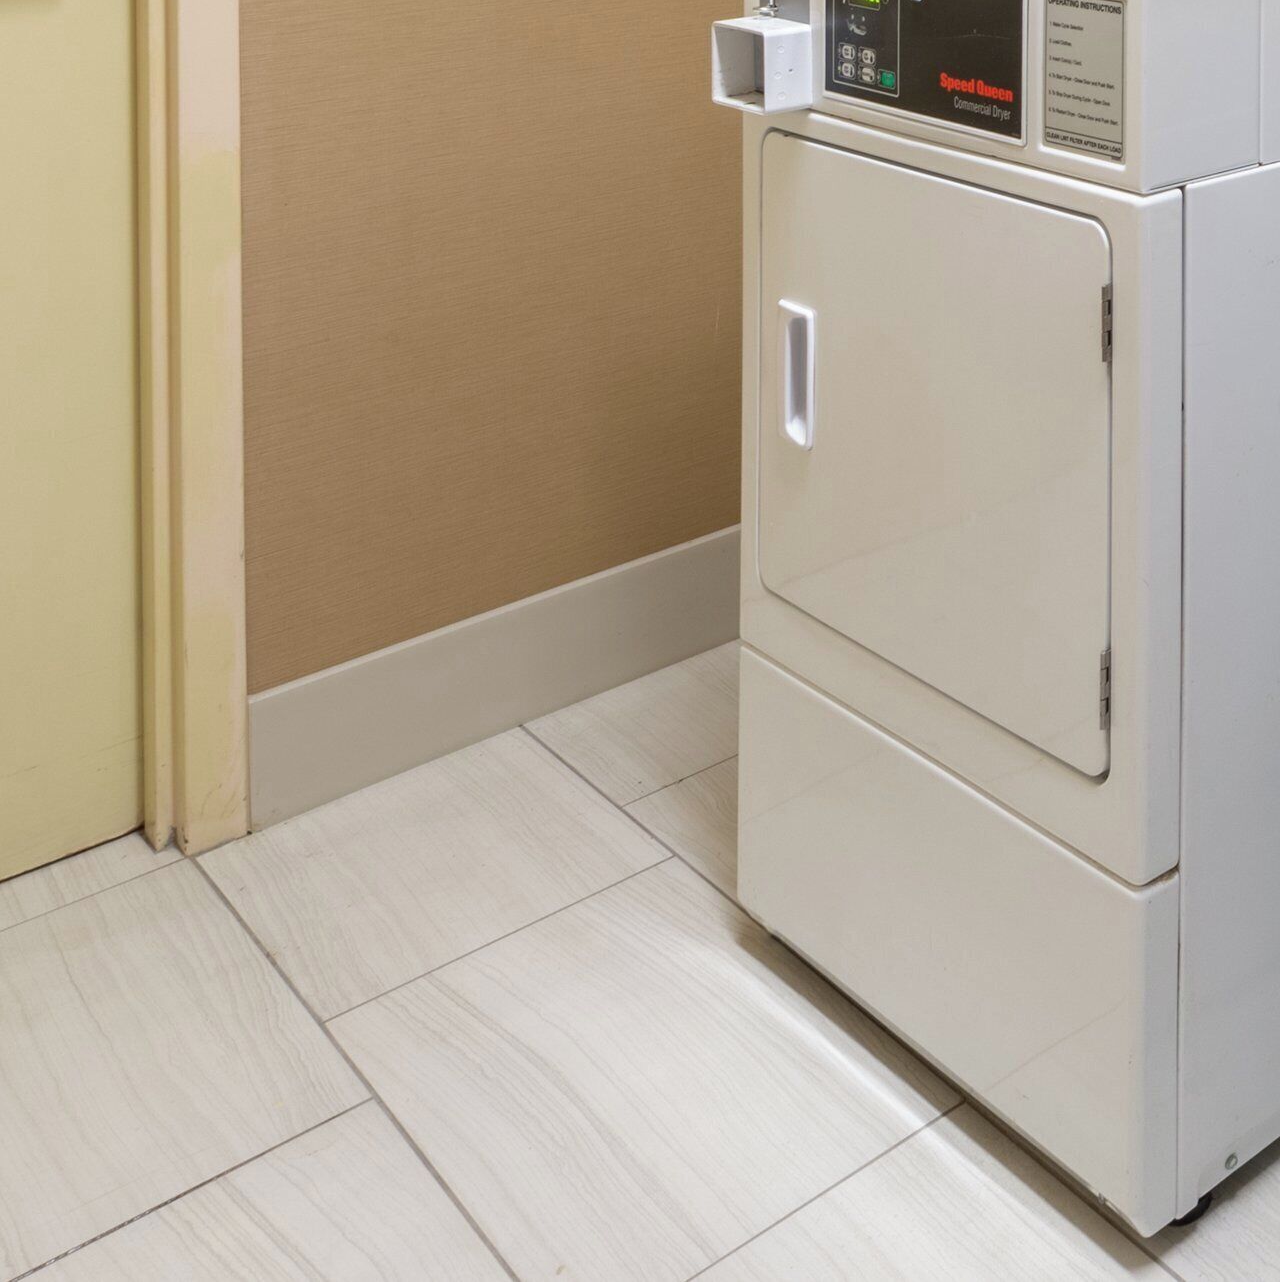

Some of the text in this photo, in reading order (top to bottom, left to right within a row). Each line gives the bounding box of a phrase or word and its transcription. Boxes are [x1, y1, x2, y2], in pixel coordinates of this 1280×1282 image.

[1080, 1, 1121, 14] INSTRUCTIONS
[939, 72, 1014, 102] Speed Queen
[954, 96, 1011, 121] Commercial Dryer
